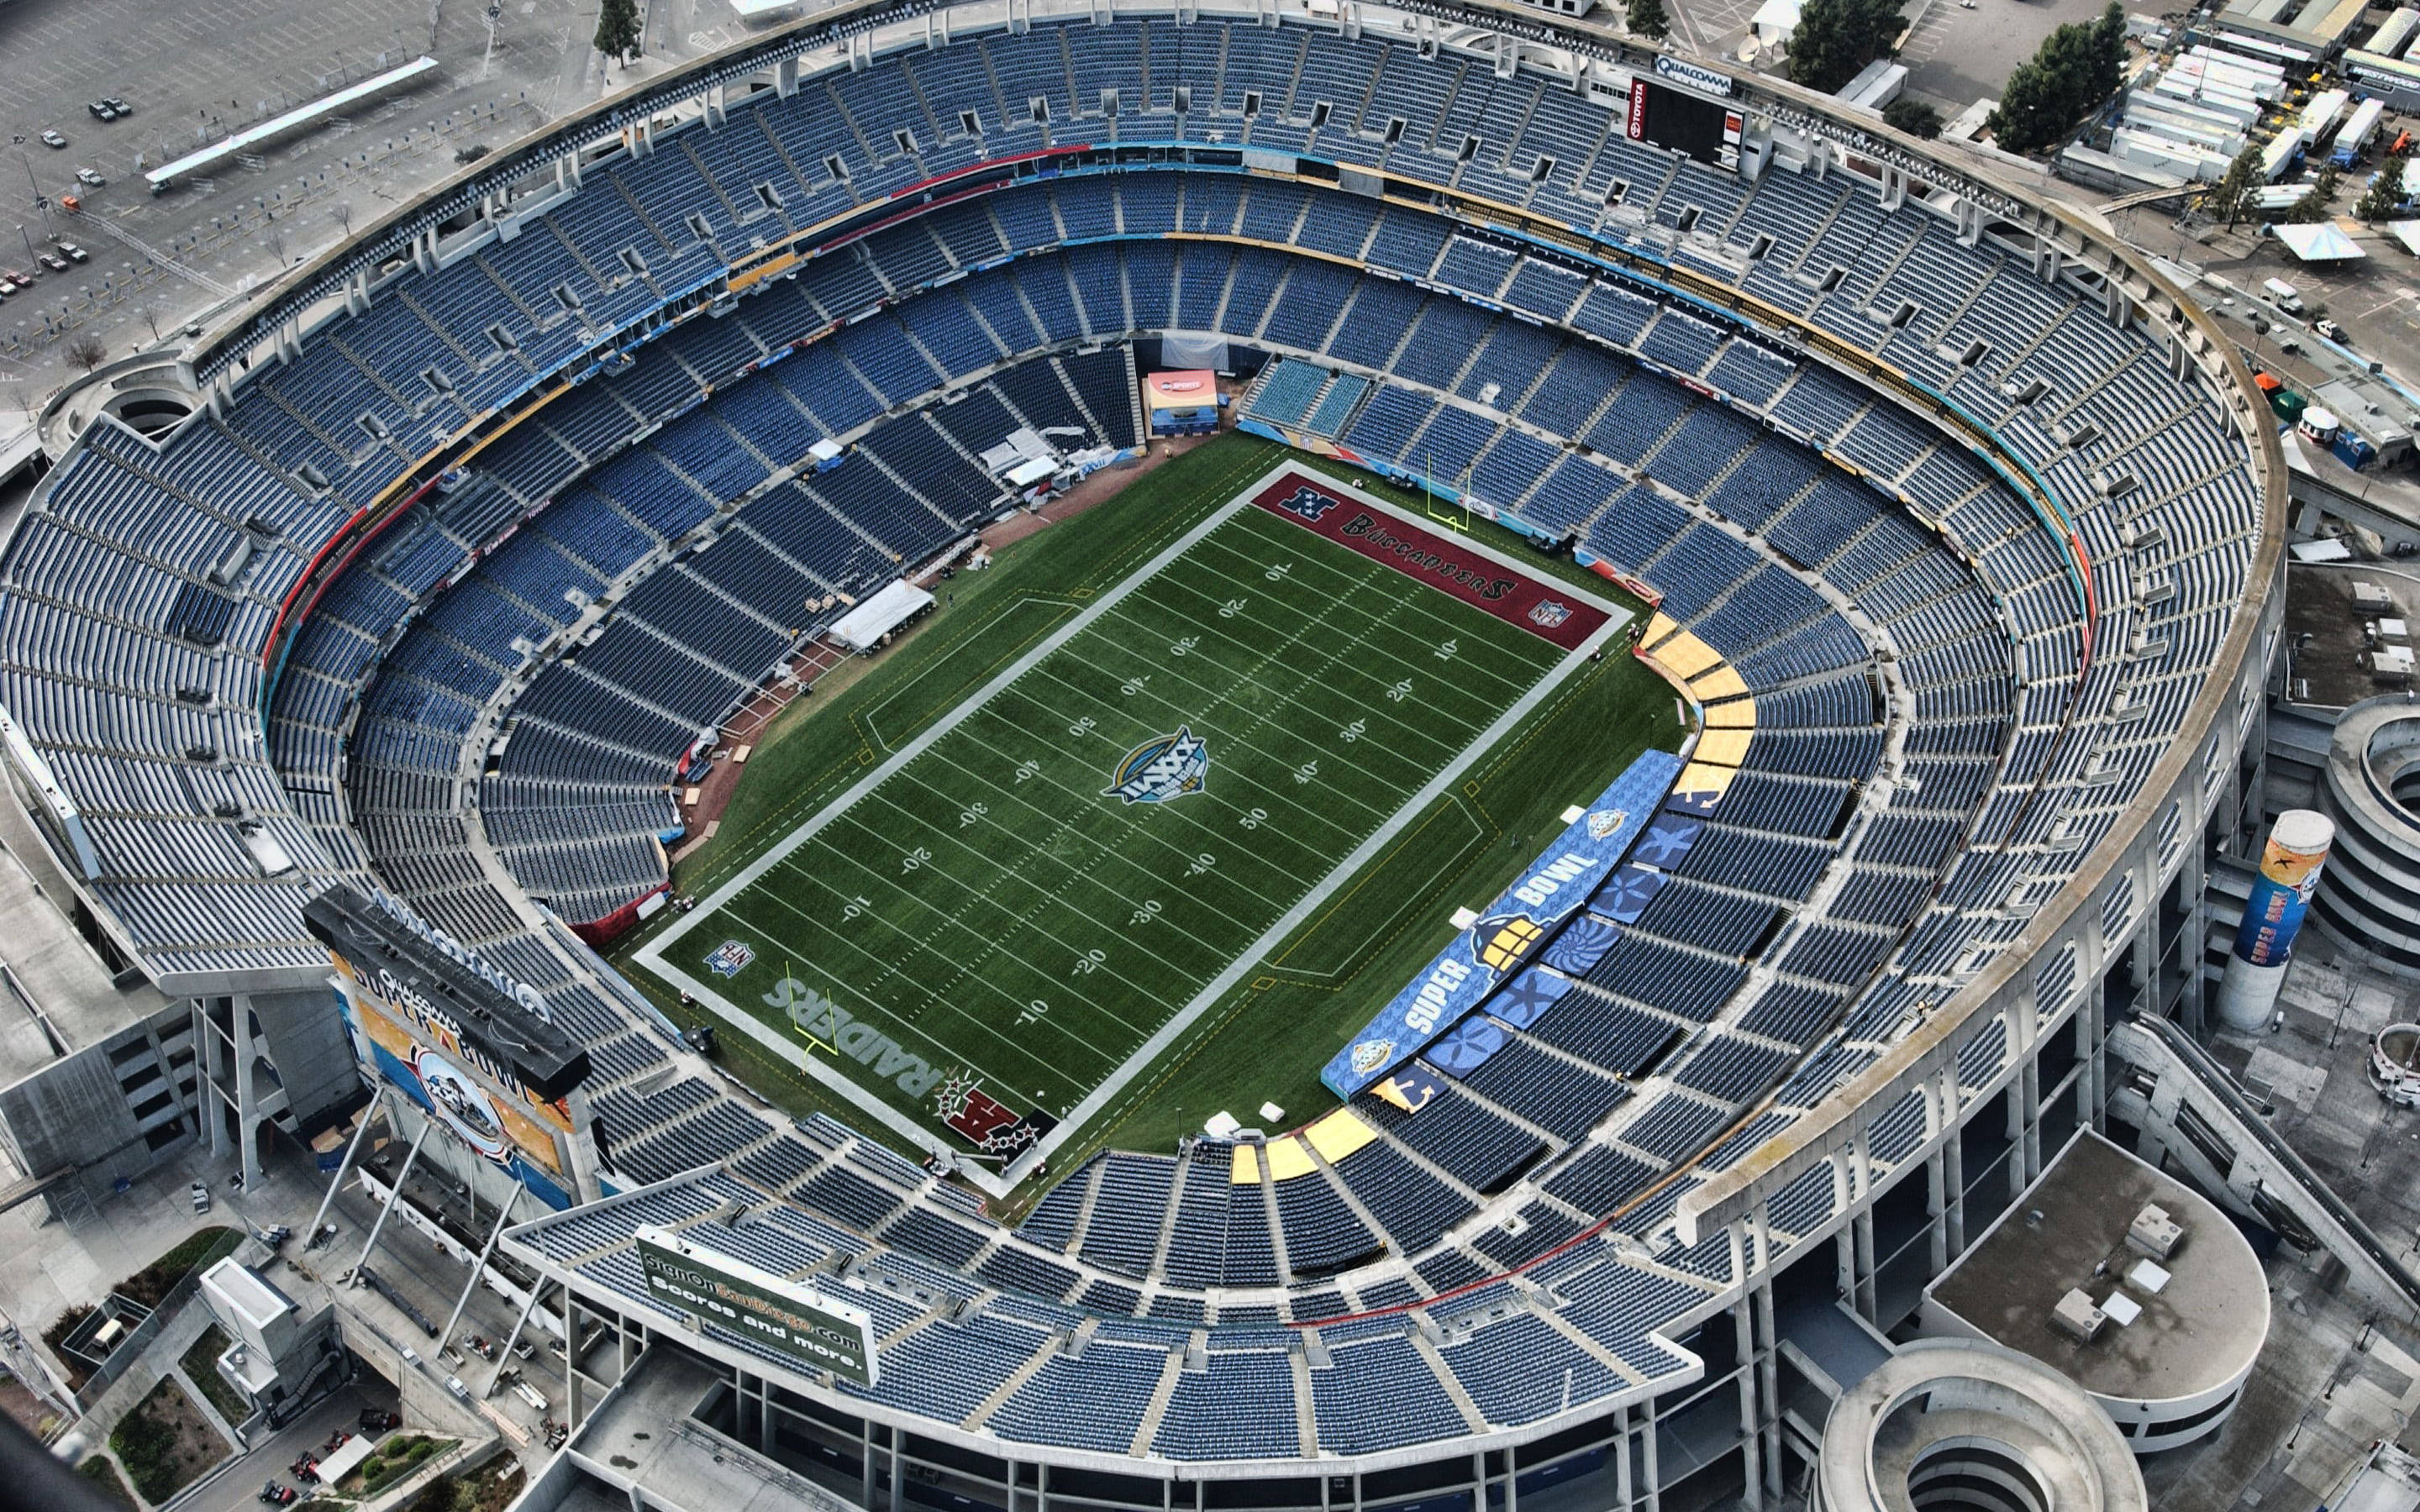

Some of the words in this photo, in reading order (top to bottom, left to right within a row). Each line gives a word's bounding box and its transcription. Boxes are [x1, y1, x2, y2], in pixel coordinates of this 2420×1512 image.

[1657, 57, 1730, 89] QUALCOMM
[1633, 84, 1644, 122] TOYOTA
[1671, 147, 1691, 159] SONY
[1434, 643, 1455, 662] 10
[1387, 681, 1412, 702] 20
[1339, 721, 1365, 743] 30
[1292, 764, 1317, 785] 40
[1239, 807, 1268, 830] 50
[1191, 853, 1217, 876] 40
[1133, 900, 1162, 926] 30
[1404, 958, 1471, 1035] SUPER
[1513, 853, 1599, 908] BOWL
[1076, 948, 1107, 976] 20
[379, 968, 463, 1039] QUALCOMM
[1020, 1000, 1050, 1026] 10
[761, 977, 945, 1099] RAIDERS
[644, 1252, 860, 1352] SignOnSanDiego.com
[651, 1274, 737, 1319] Scores
[743, 1315, 786, 1340] and
[793, 1334, 863, 1371] more.
